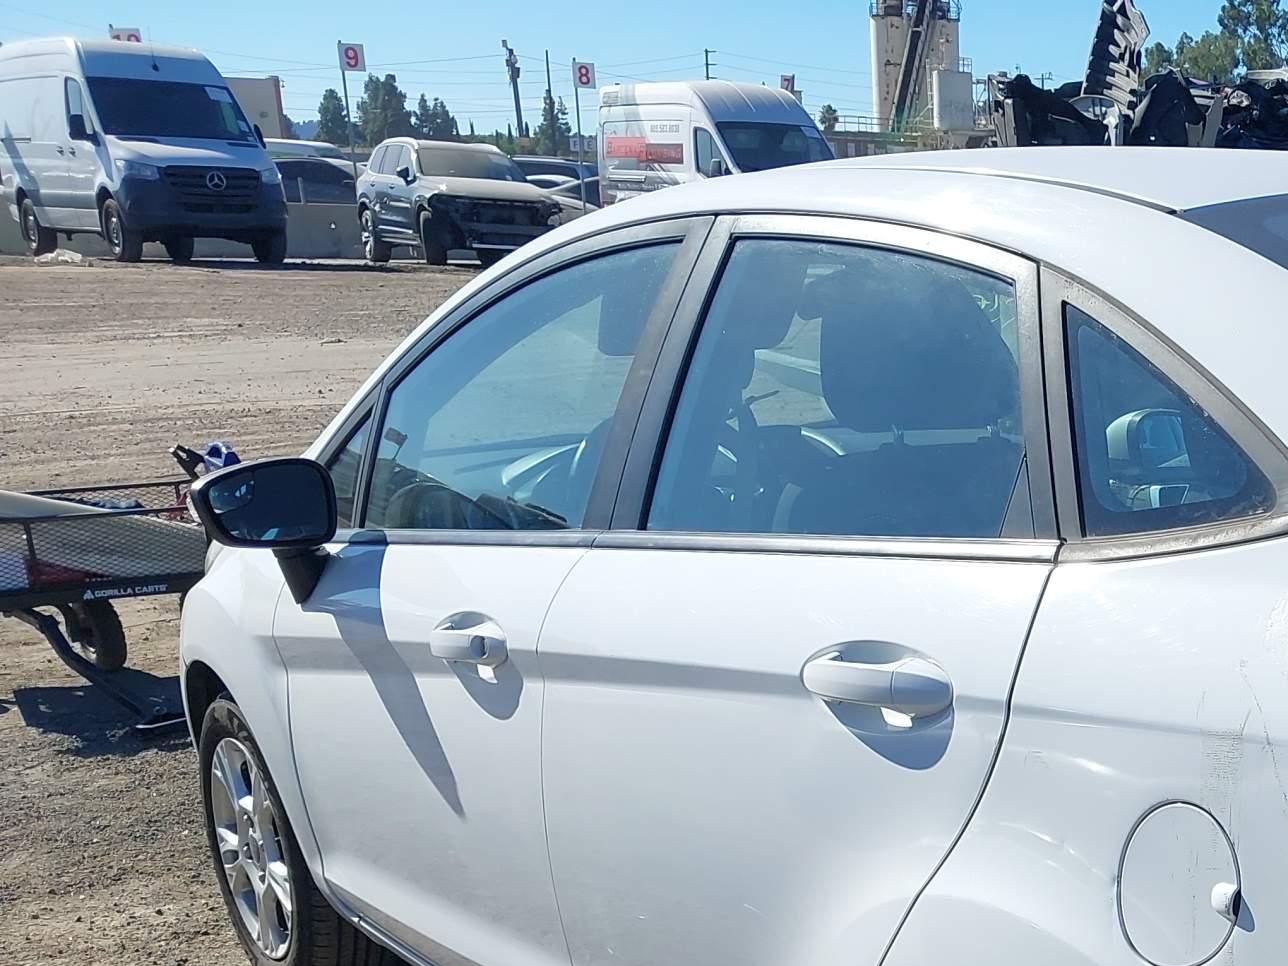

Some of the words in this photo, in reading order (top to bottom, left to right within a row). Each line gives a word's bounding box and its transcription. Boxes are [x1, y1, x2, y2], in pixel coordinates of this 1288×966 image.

[344, 46, 359, 68] 9
[578, 65, 591, 85] 8
[783, 78, 792, 91] 7
[94, 587, 133, 598] GORILLA
[135, 584, 167, 594] CARTS
